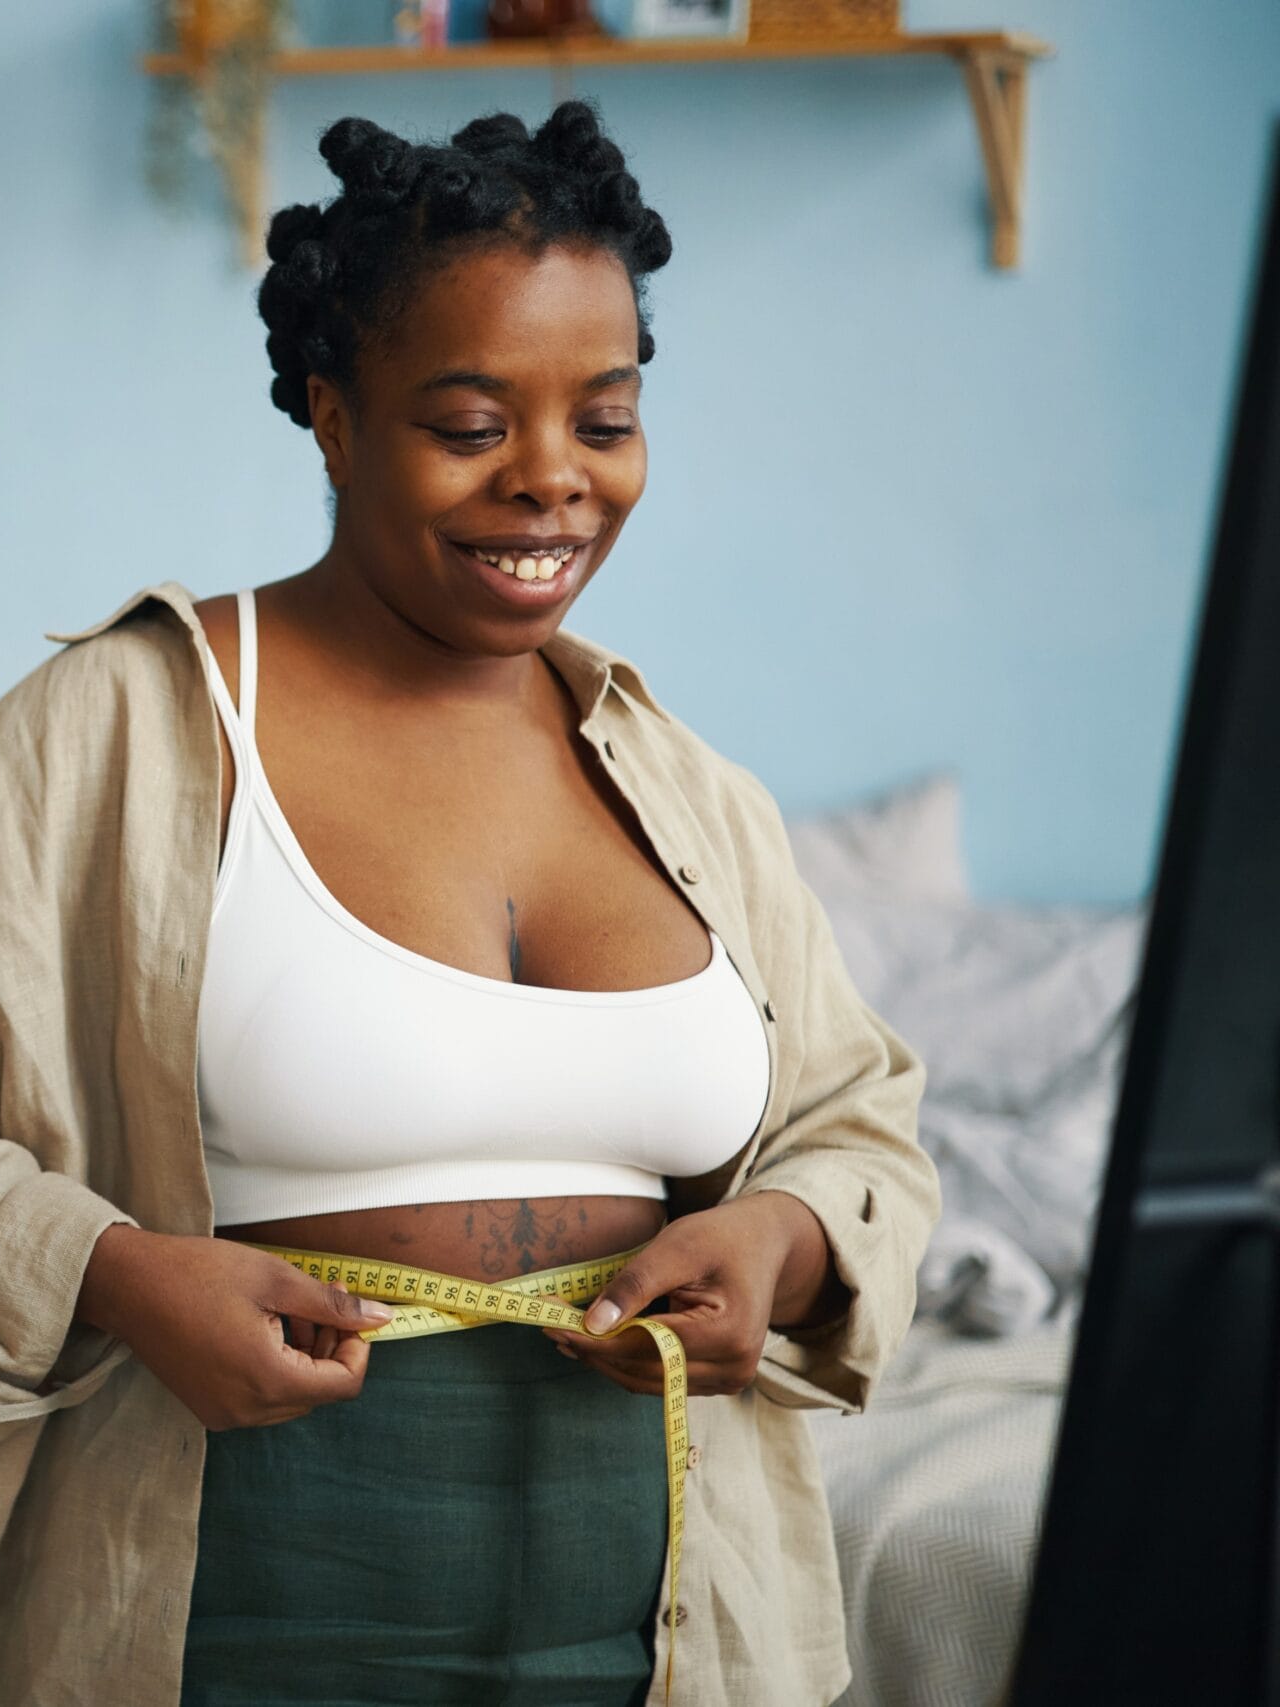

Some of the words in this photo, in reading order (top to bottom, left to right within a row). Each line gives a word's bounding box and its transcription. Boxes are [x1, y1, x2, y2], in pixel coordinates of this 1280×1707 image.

[327, 1266, 339, 1282] 90
[346, 1270, 359, 1284] 91
[365, 1271, 378, 1288] 92
[592, 1273, 601, 1288] 15
[385, 1274, 398, 1290] 93
[404, 1277, 418, 1292] 94
[424, 1281, 438, 1296] 95
[561, 1280, 572, 1295] 13
[577, 1277, 587, 1292] 14
[444, 1286, 459, 1301] 96
[464, 1290, 479, 1304] 97
[485, 1294, 499, 1308] 98
[506, 1299, 520, 1312] 99
[525, 1301, 541, 1318] 100
[395, 1315, 407, 1324] 3
[411, 1313, 422, 1321] 4
[429, 1311, 440, 1319] 5
[547, 1307, 562, 1321] 101
[568, 1312, 582, 1326] 102
[661, 1333, 674, 1349] 107
[668, 1353, 681, 1369] 108
[670, 1374, 683, 1390] 109
[671, 1396, 683, 1411] 110
[673, 1416, 684, 1431] 111
[674, 1436, 686, 1452] 112
[675, 1457, 686, 1472] 113
